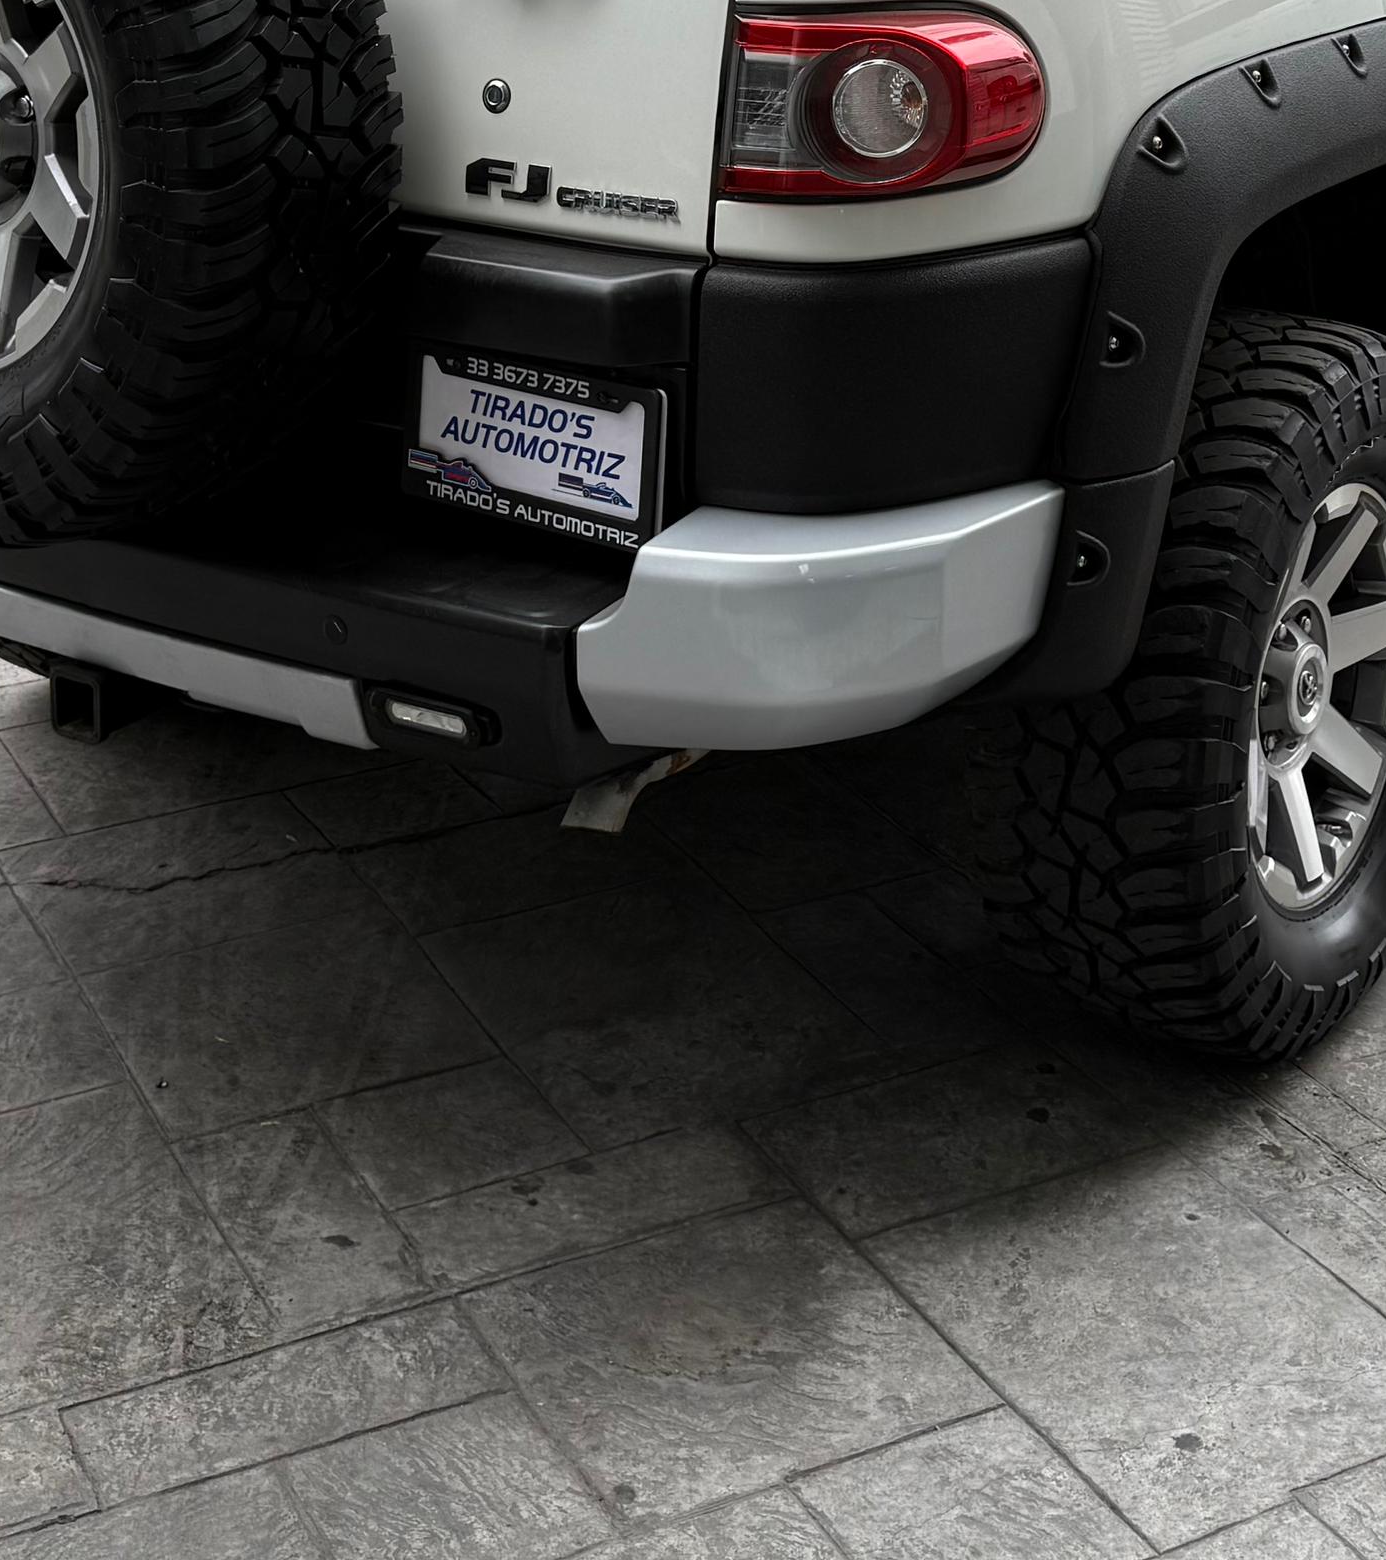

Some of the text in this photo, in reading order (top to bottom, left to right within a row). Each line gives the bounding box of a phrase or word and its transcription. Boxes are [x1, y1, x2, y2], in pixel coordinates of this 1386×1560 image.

[465, 157, 680, 220] FJ CRUISER
[466, 357, 590, 399] 33 3673 7375
[470, 389, 595, 440] TIRADO'S
[441, 415, 626, 480] AUTOMOTRIZ
[426, 480, 639, 549] TIRADO'S AUTOMOTRIZ
